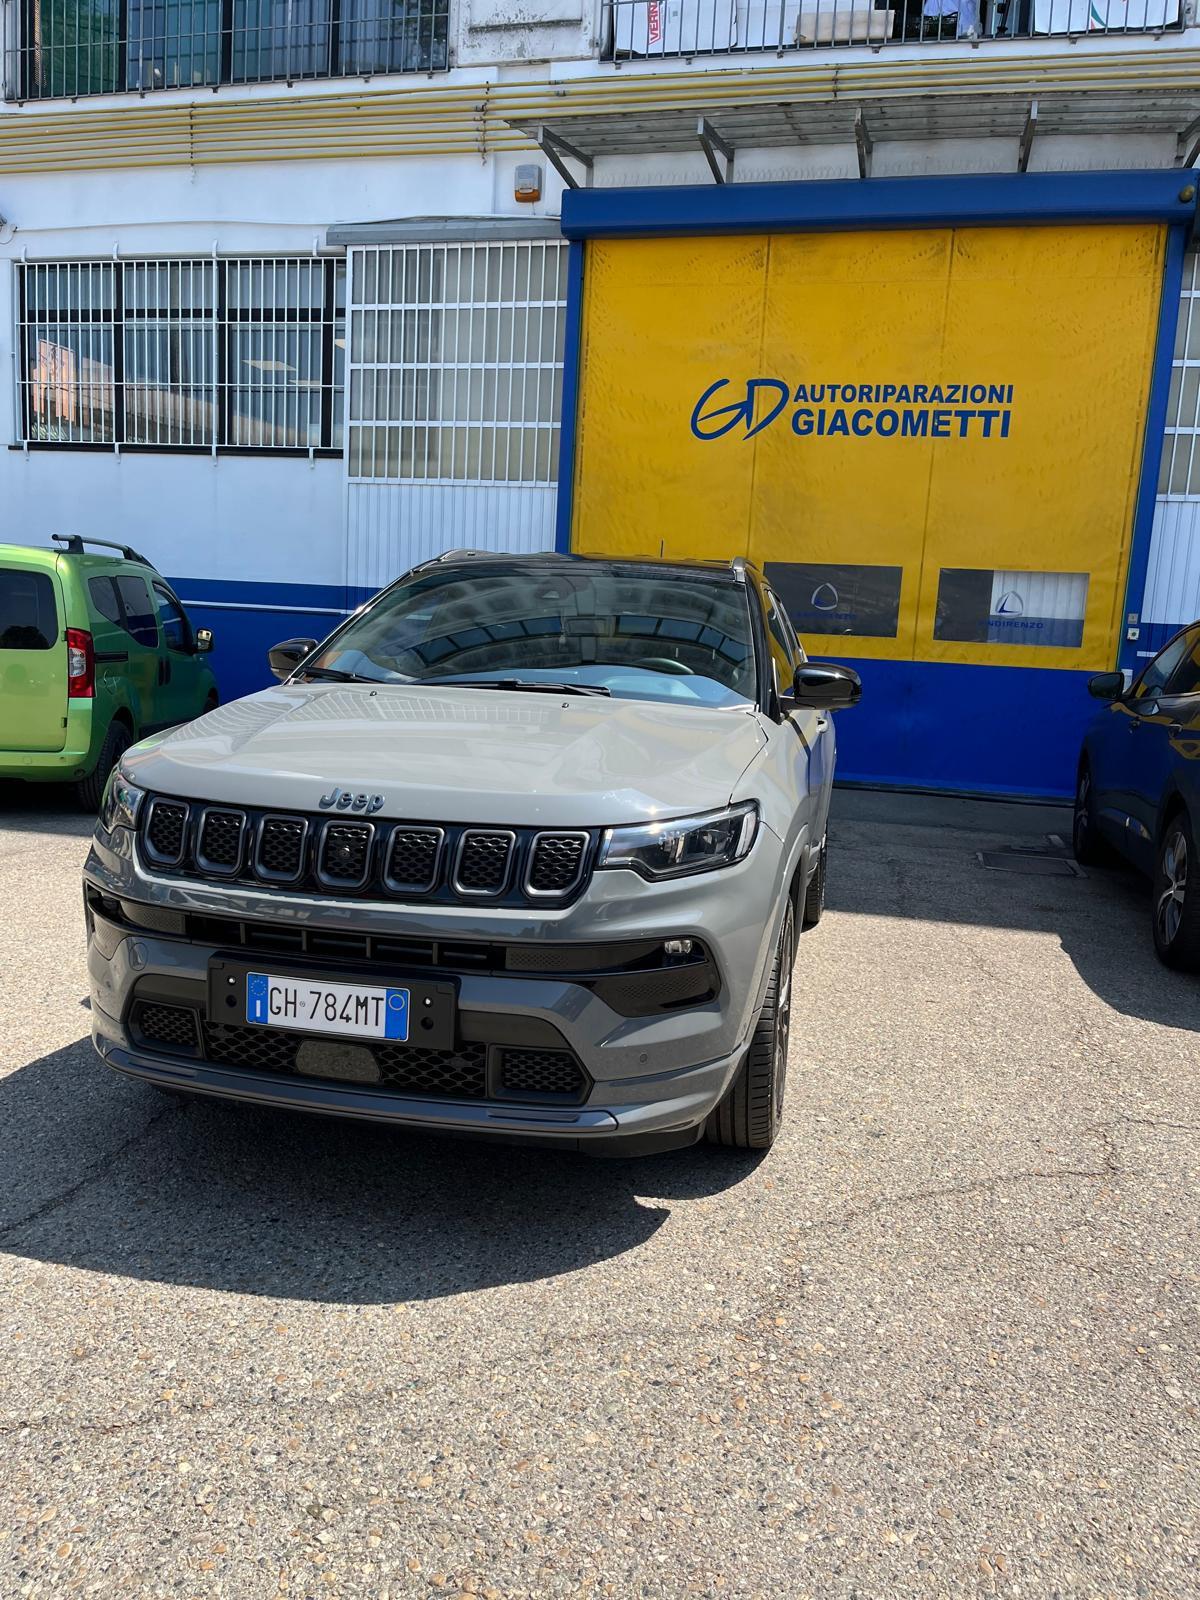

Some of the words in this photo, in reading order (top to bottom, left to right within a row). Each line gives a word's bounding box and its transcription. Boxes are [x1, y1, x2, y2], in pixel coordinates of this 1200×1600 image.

[649, 0, 659, 41] VERN
[793, 384, 1014, 404] AUTORIPARAZIONI
[791, 409, 1011, 438] GIACOMETTI
[319, 787, 386, 815] Jeep
